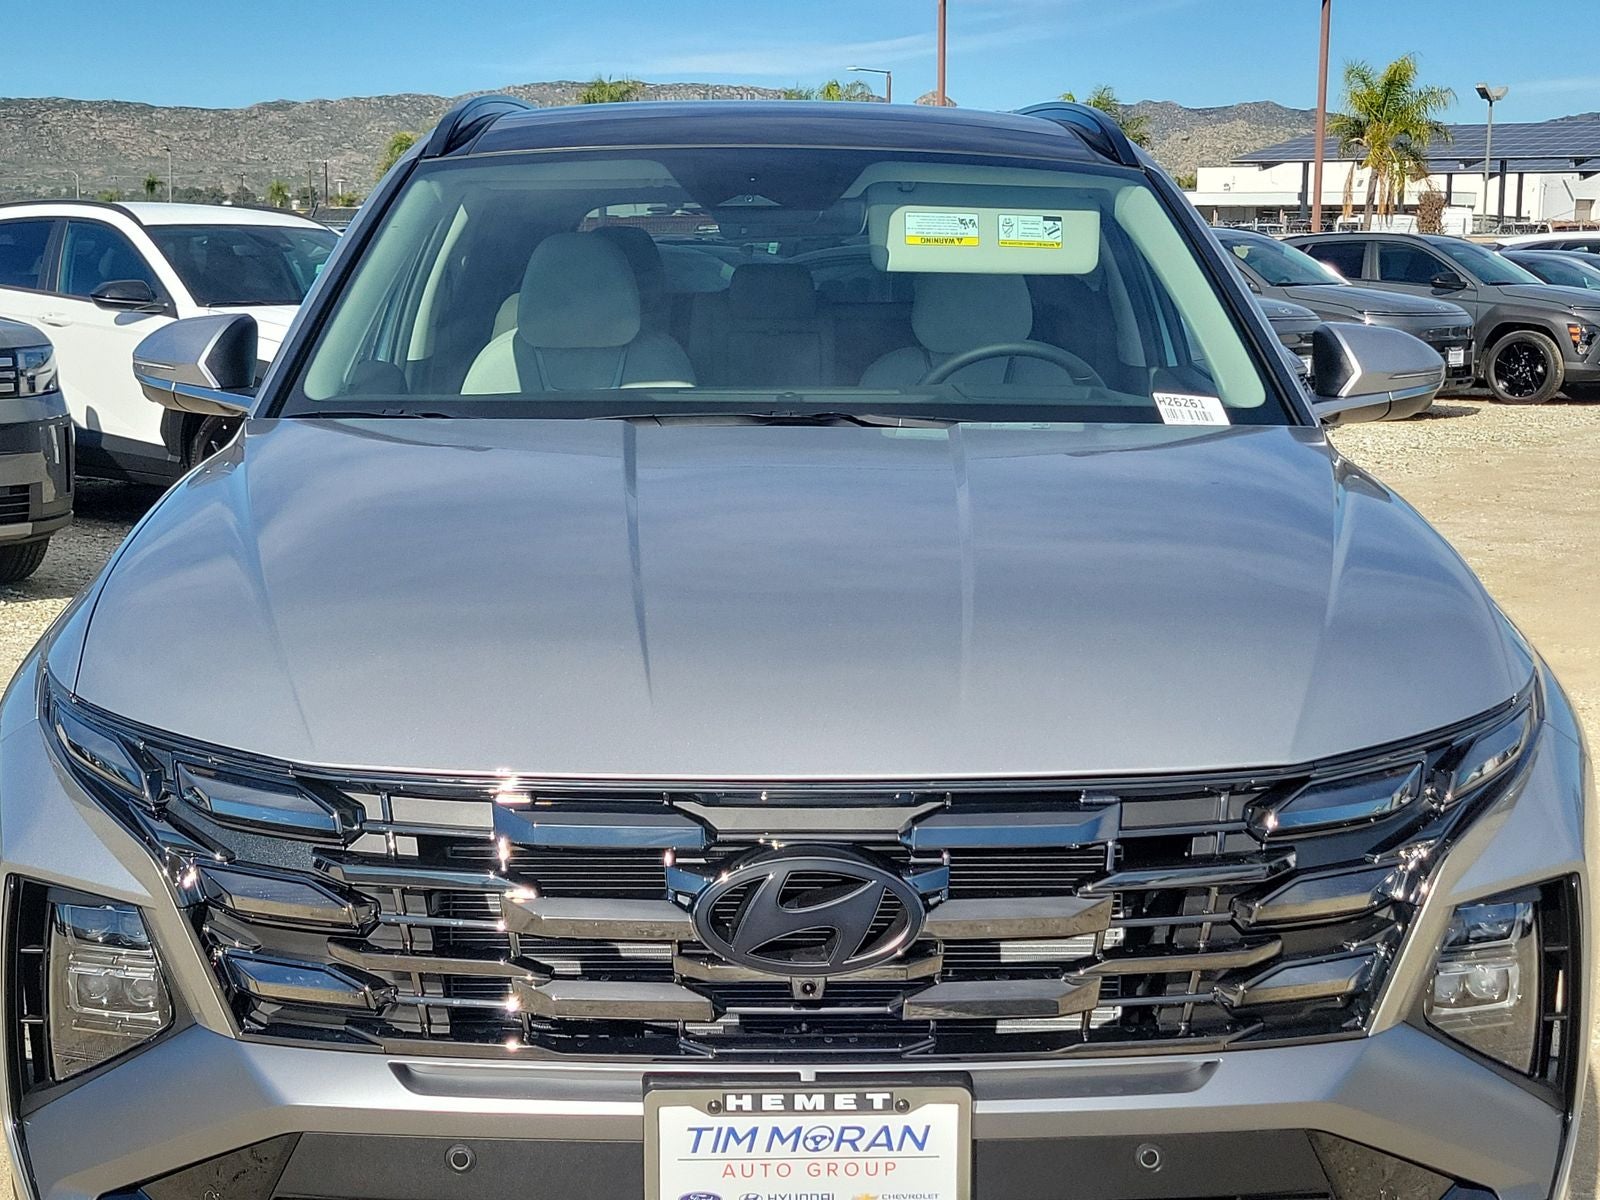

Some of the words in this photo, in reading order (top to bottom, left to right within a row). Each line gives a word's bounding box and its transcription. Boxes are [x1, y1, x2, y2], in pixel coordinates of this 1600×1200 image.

[920, 237, 956, 245] WARNING
[1157, 396, 1205, 409] H26261
[725, 1093, 891, 1112] HEMET
[687, 1126, 759, 1153] TIM
[765, 1125, 931, 1152] MORAN
[722, 1163, 791, 1178] AUTO
[807, 1161, 897, 1177] GROUP
